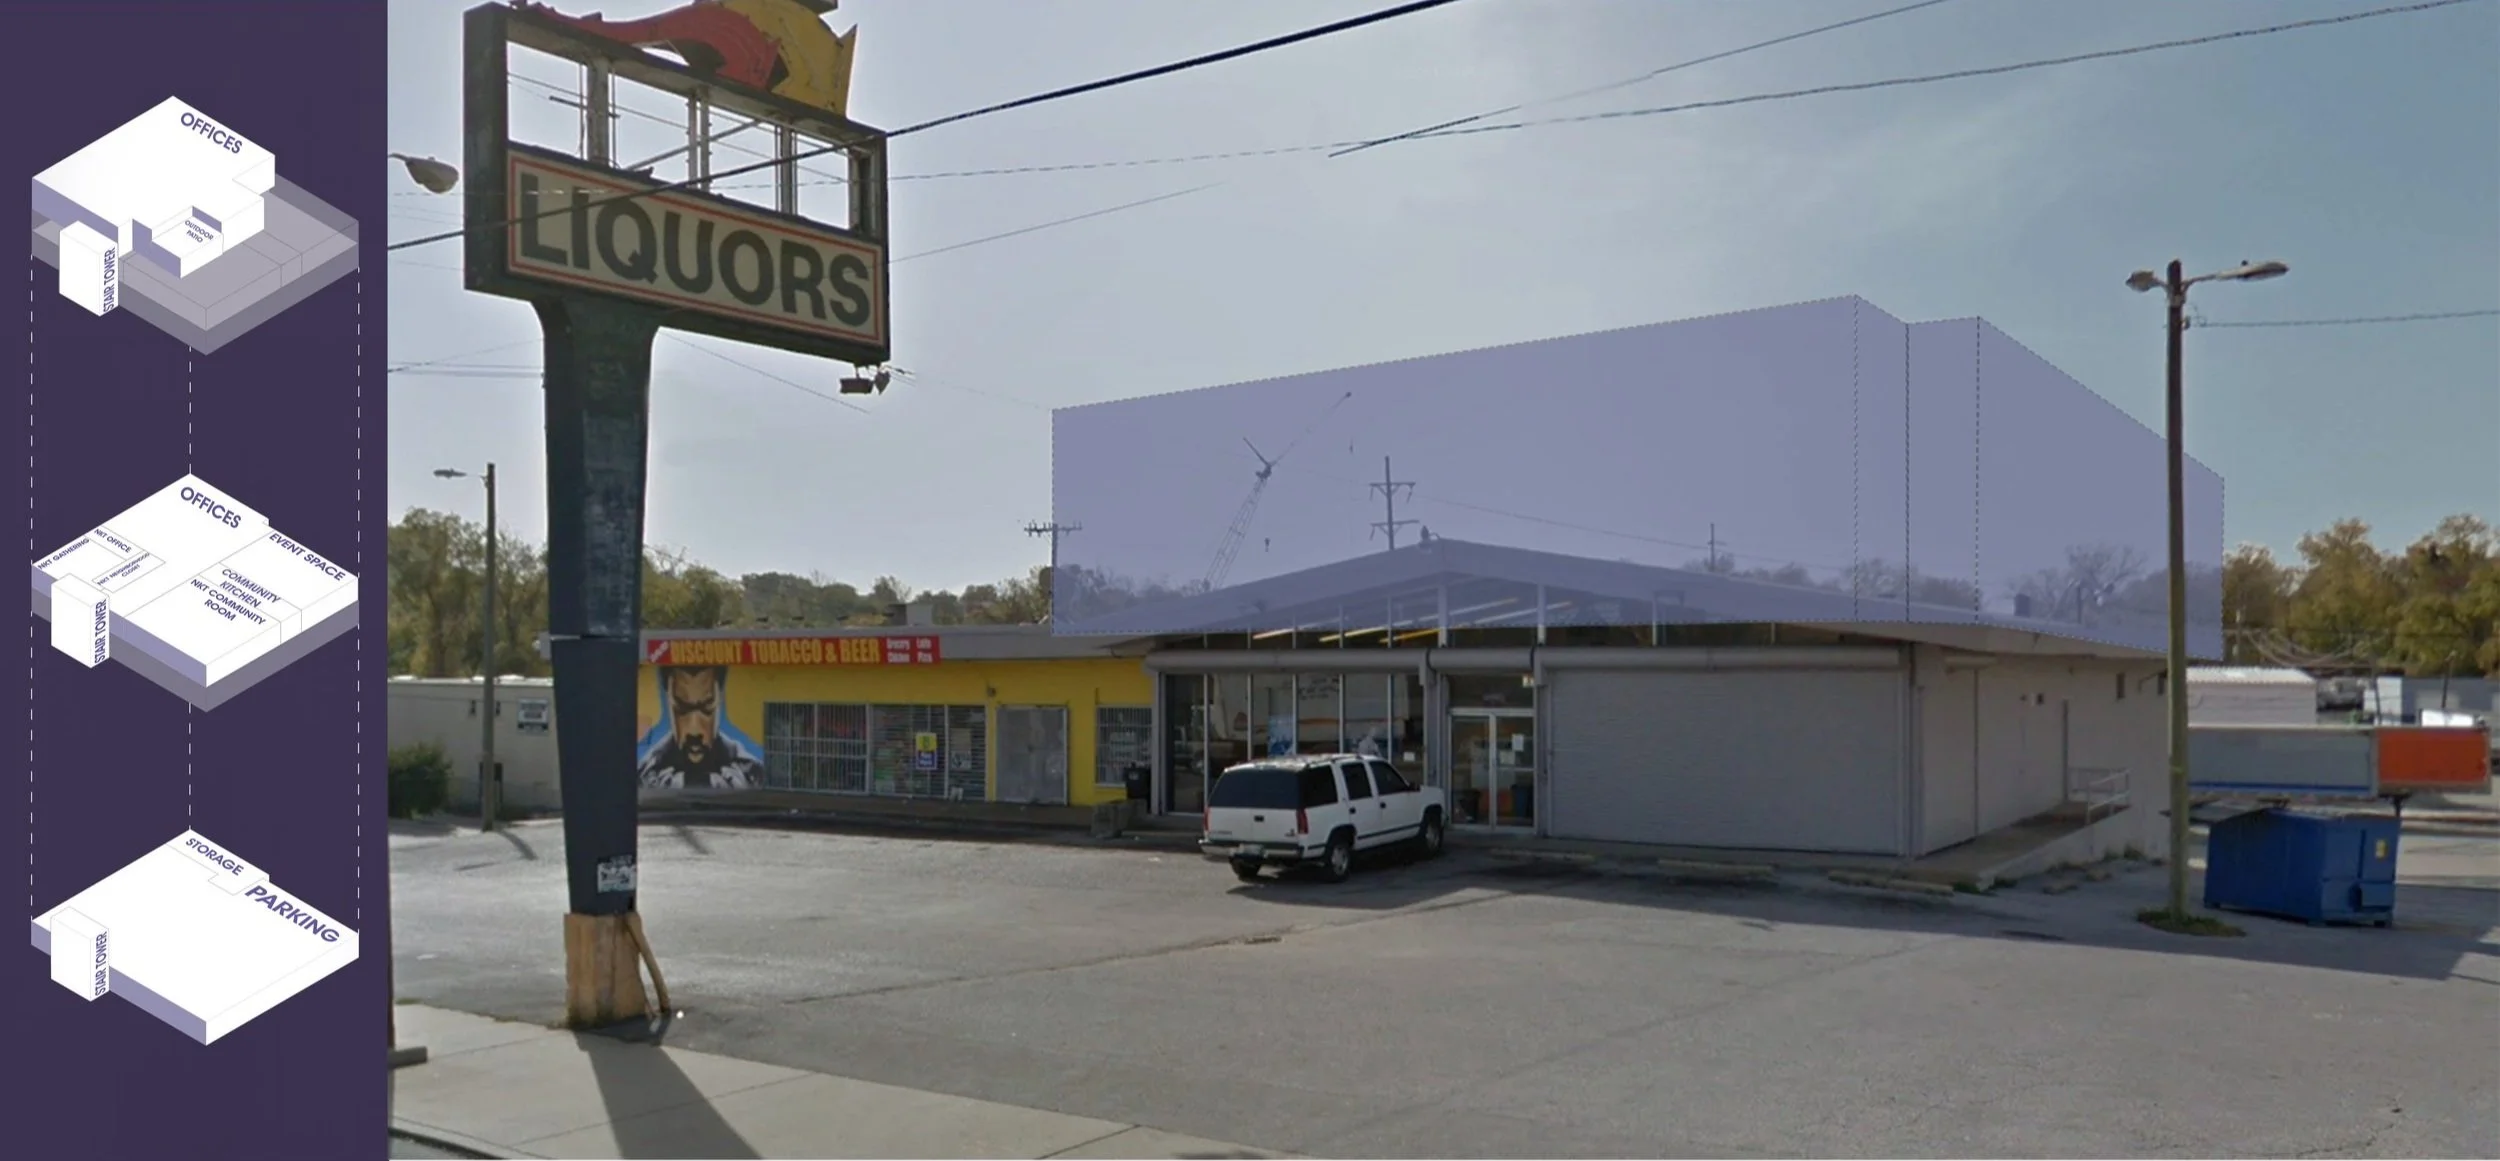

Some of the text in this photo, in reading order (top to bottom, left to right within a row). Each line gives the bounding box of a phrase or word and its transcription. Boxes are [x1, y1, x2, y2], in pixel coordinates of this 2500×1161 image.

[519, 172, 872, 327] LIQUORS
[670, 639, 742, 664] DISCOUNT
[747, 638, 822, 664] TOBACCO
[825, 642, 837, 663] &
[840, 638, 881, 663] BEER
